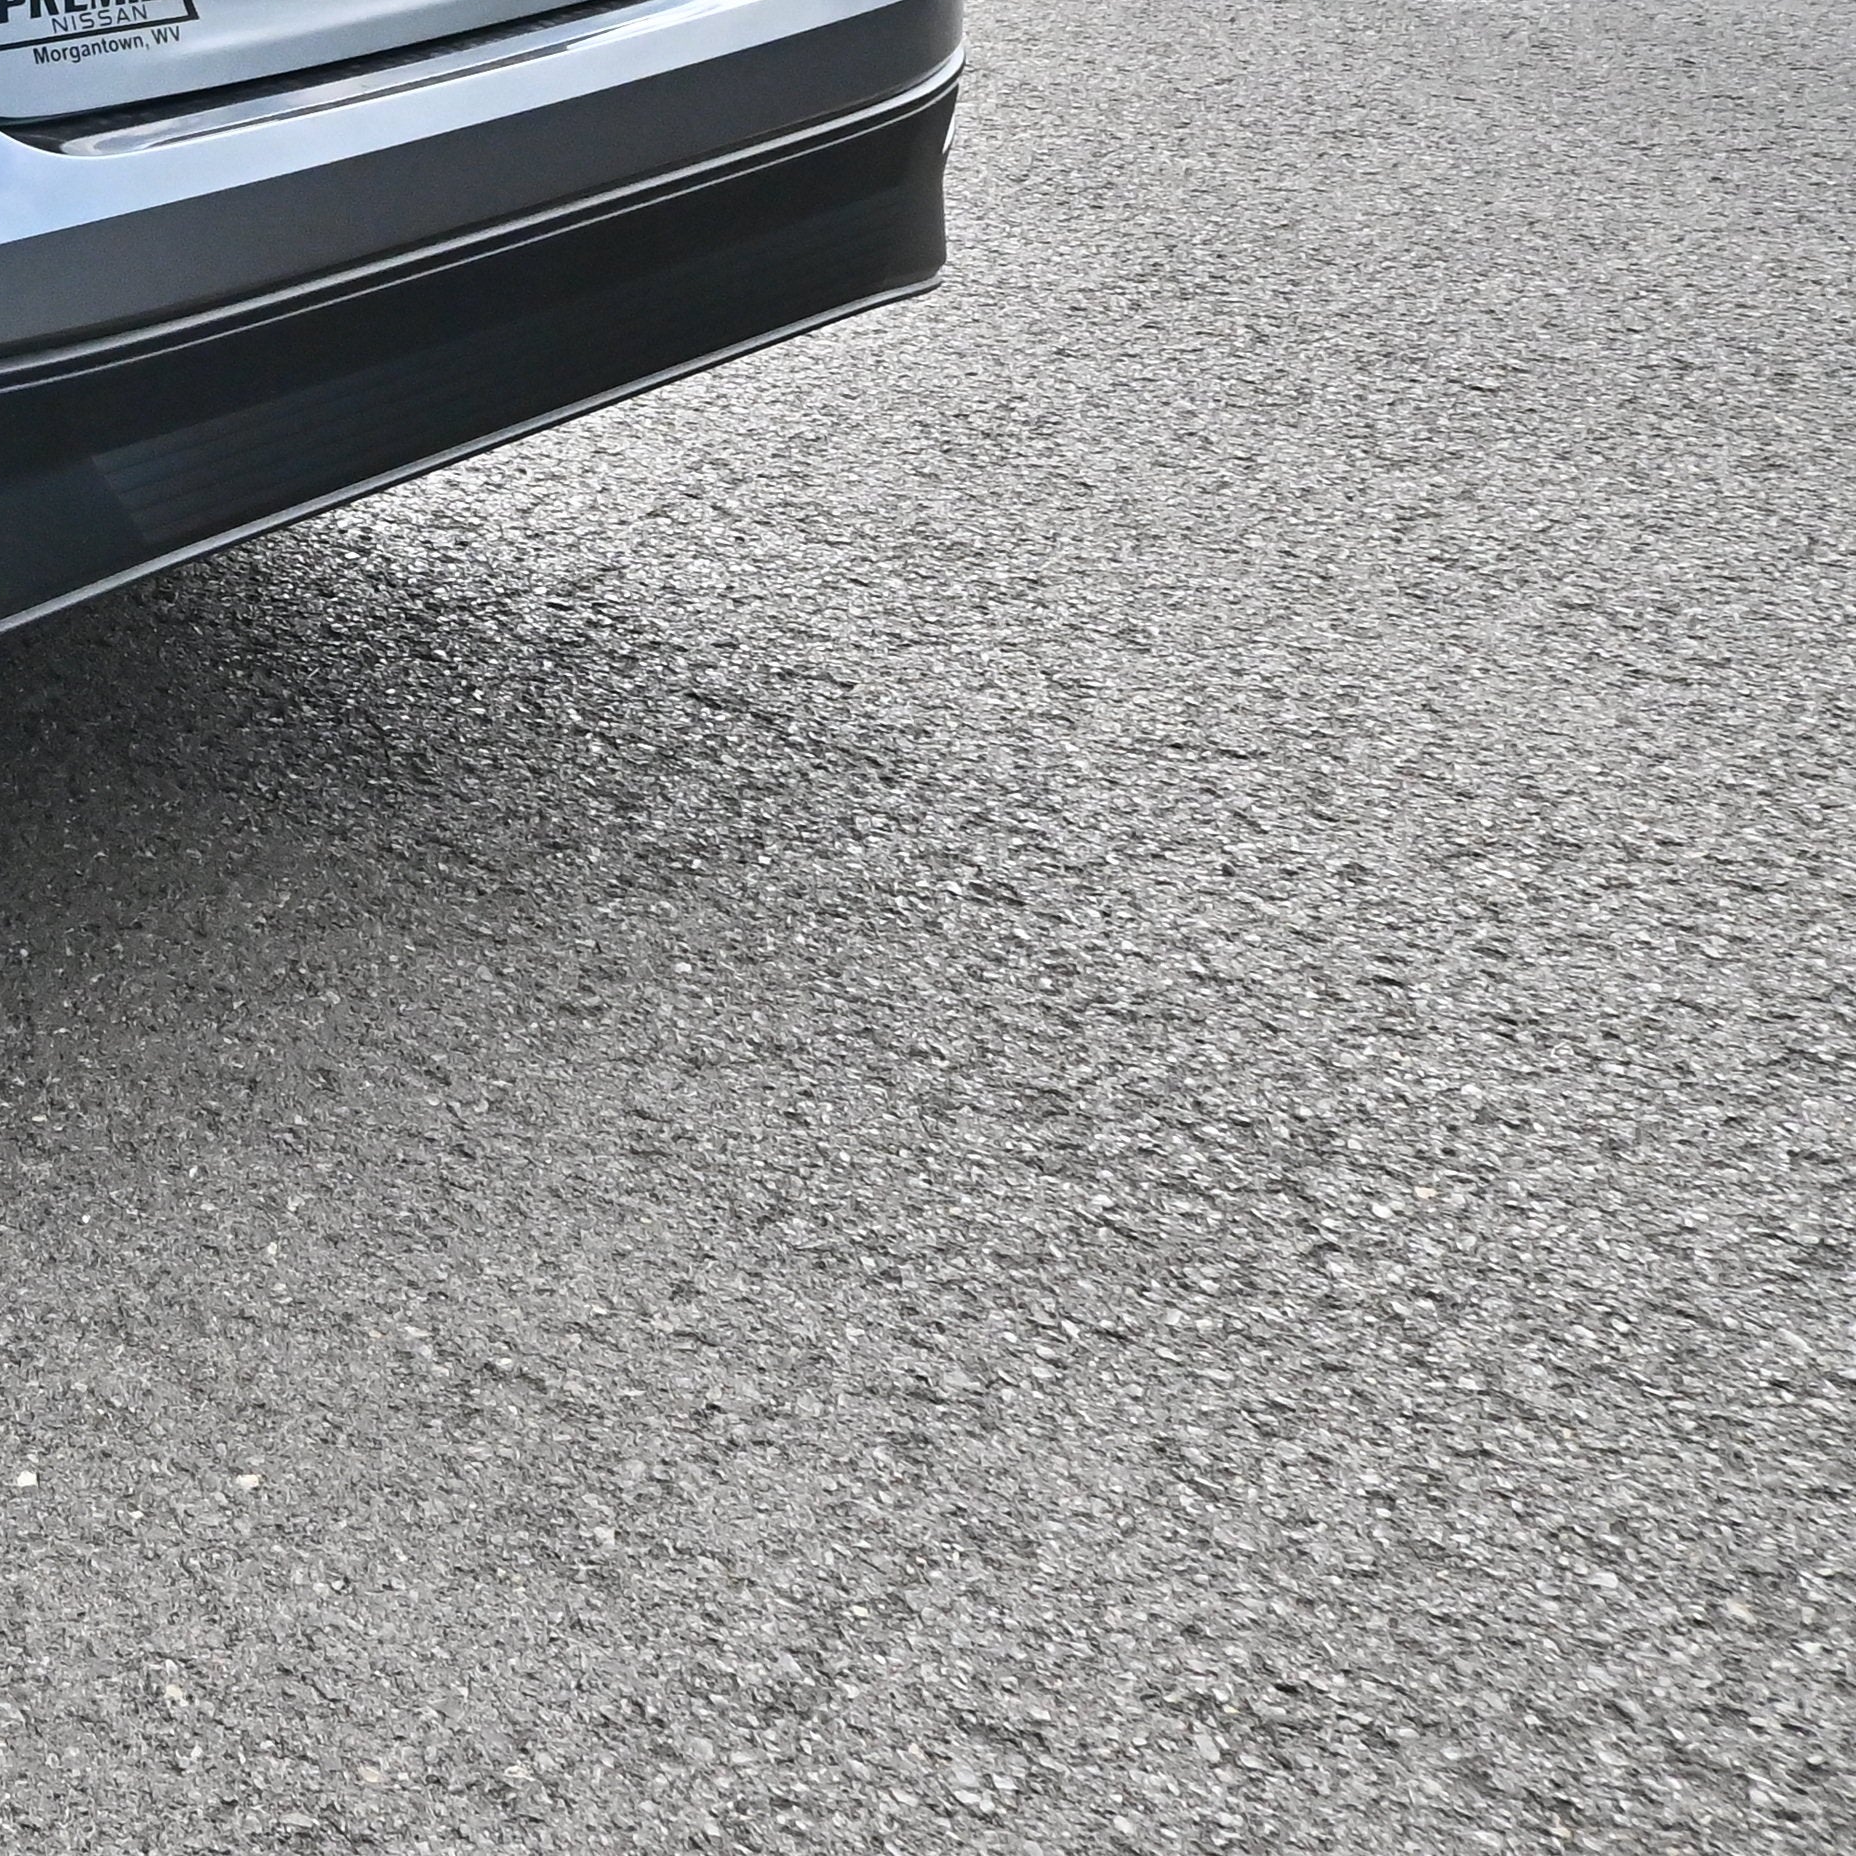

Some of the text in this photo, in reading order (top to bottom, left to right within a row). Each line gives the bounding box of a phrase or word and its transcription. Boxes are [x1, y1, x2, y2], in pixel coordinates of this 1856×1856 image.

[52, 4, 148, 34] NISSAN
[33, 26, 181, 64] Morgantown, WV
